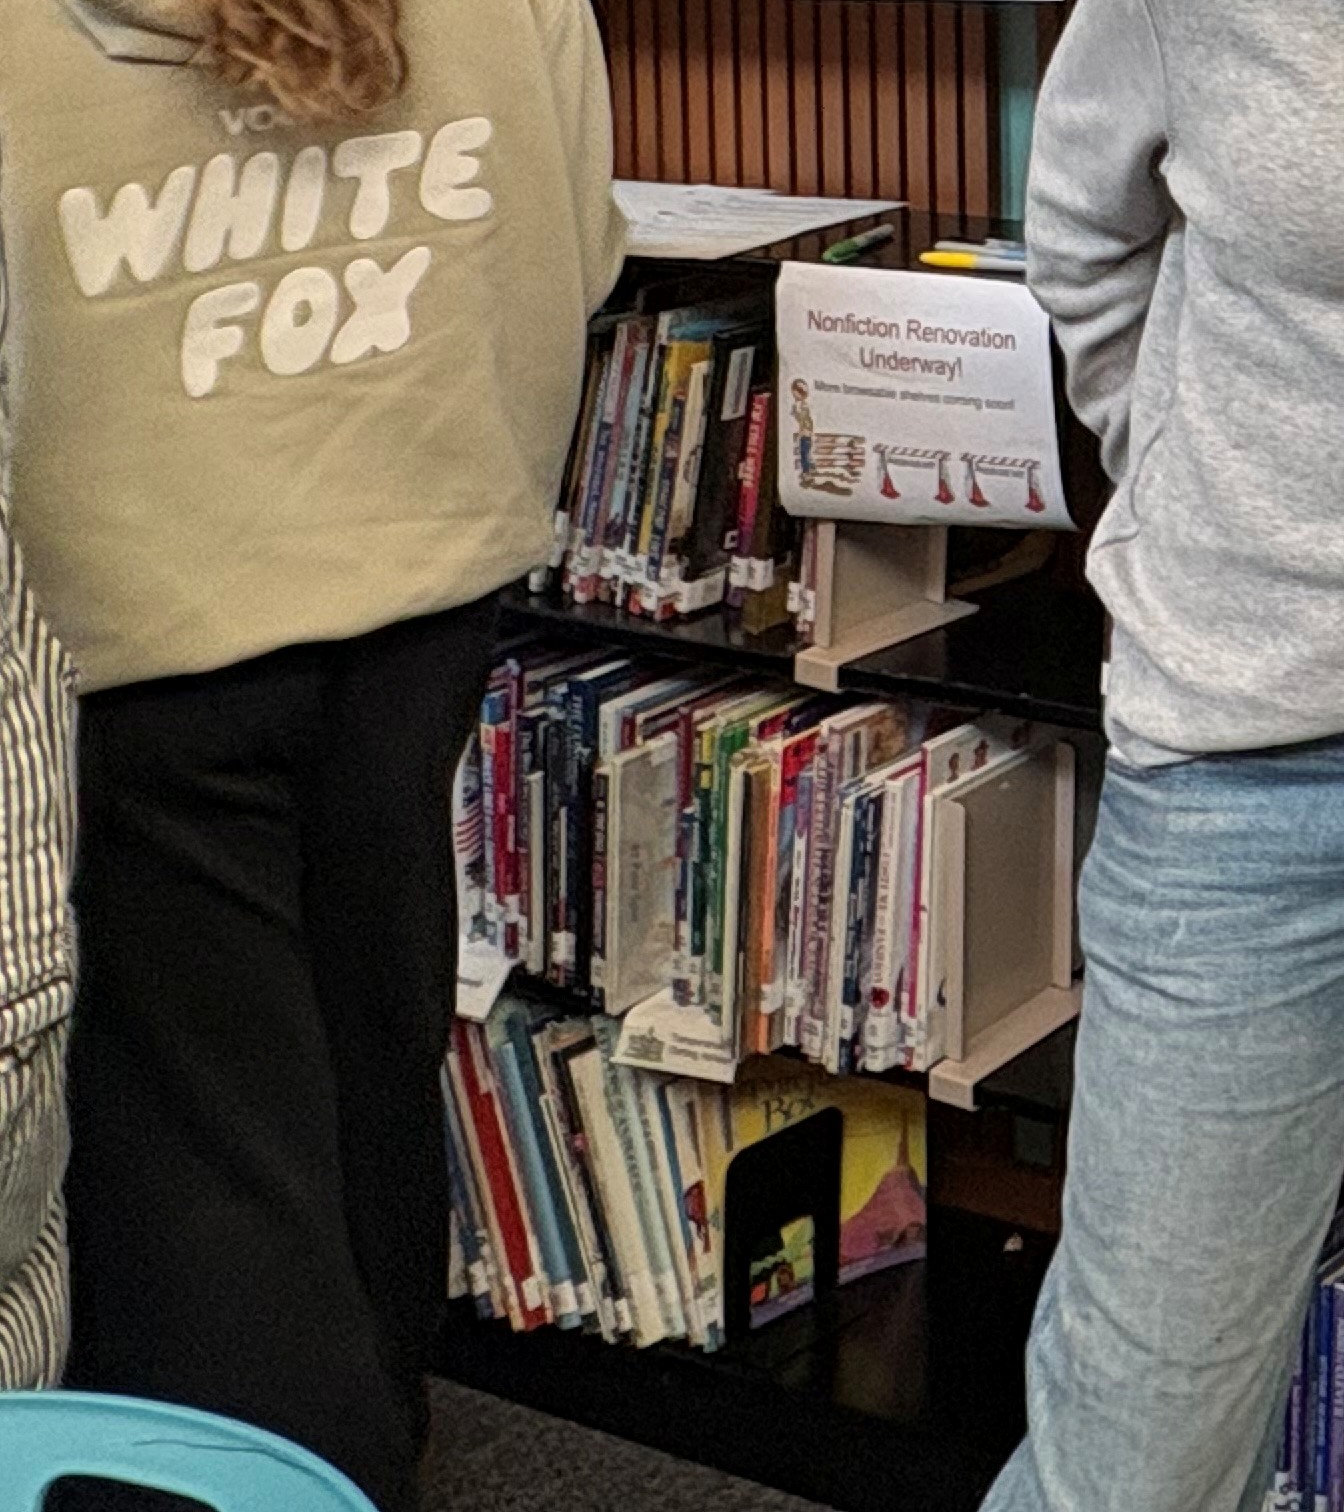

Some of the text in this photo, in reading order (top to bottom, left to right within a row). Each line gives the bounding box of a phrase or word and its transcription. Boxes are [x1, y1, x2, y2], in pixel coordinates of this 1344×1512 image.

[57, 116, 494, 298] WHITE
[180, 245, 433, 400] FOX
[807, 310, 1018, 352] Nonfiction Renovation
[859, 345, 965, 383] Underway!
